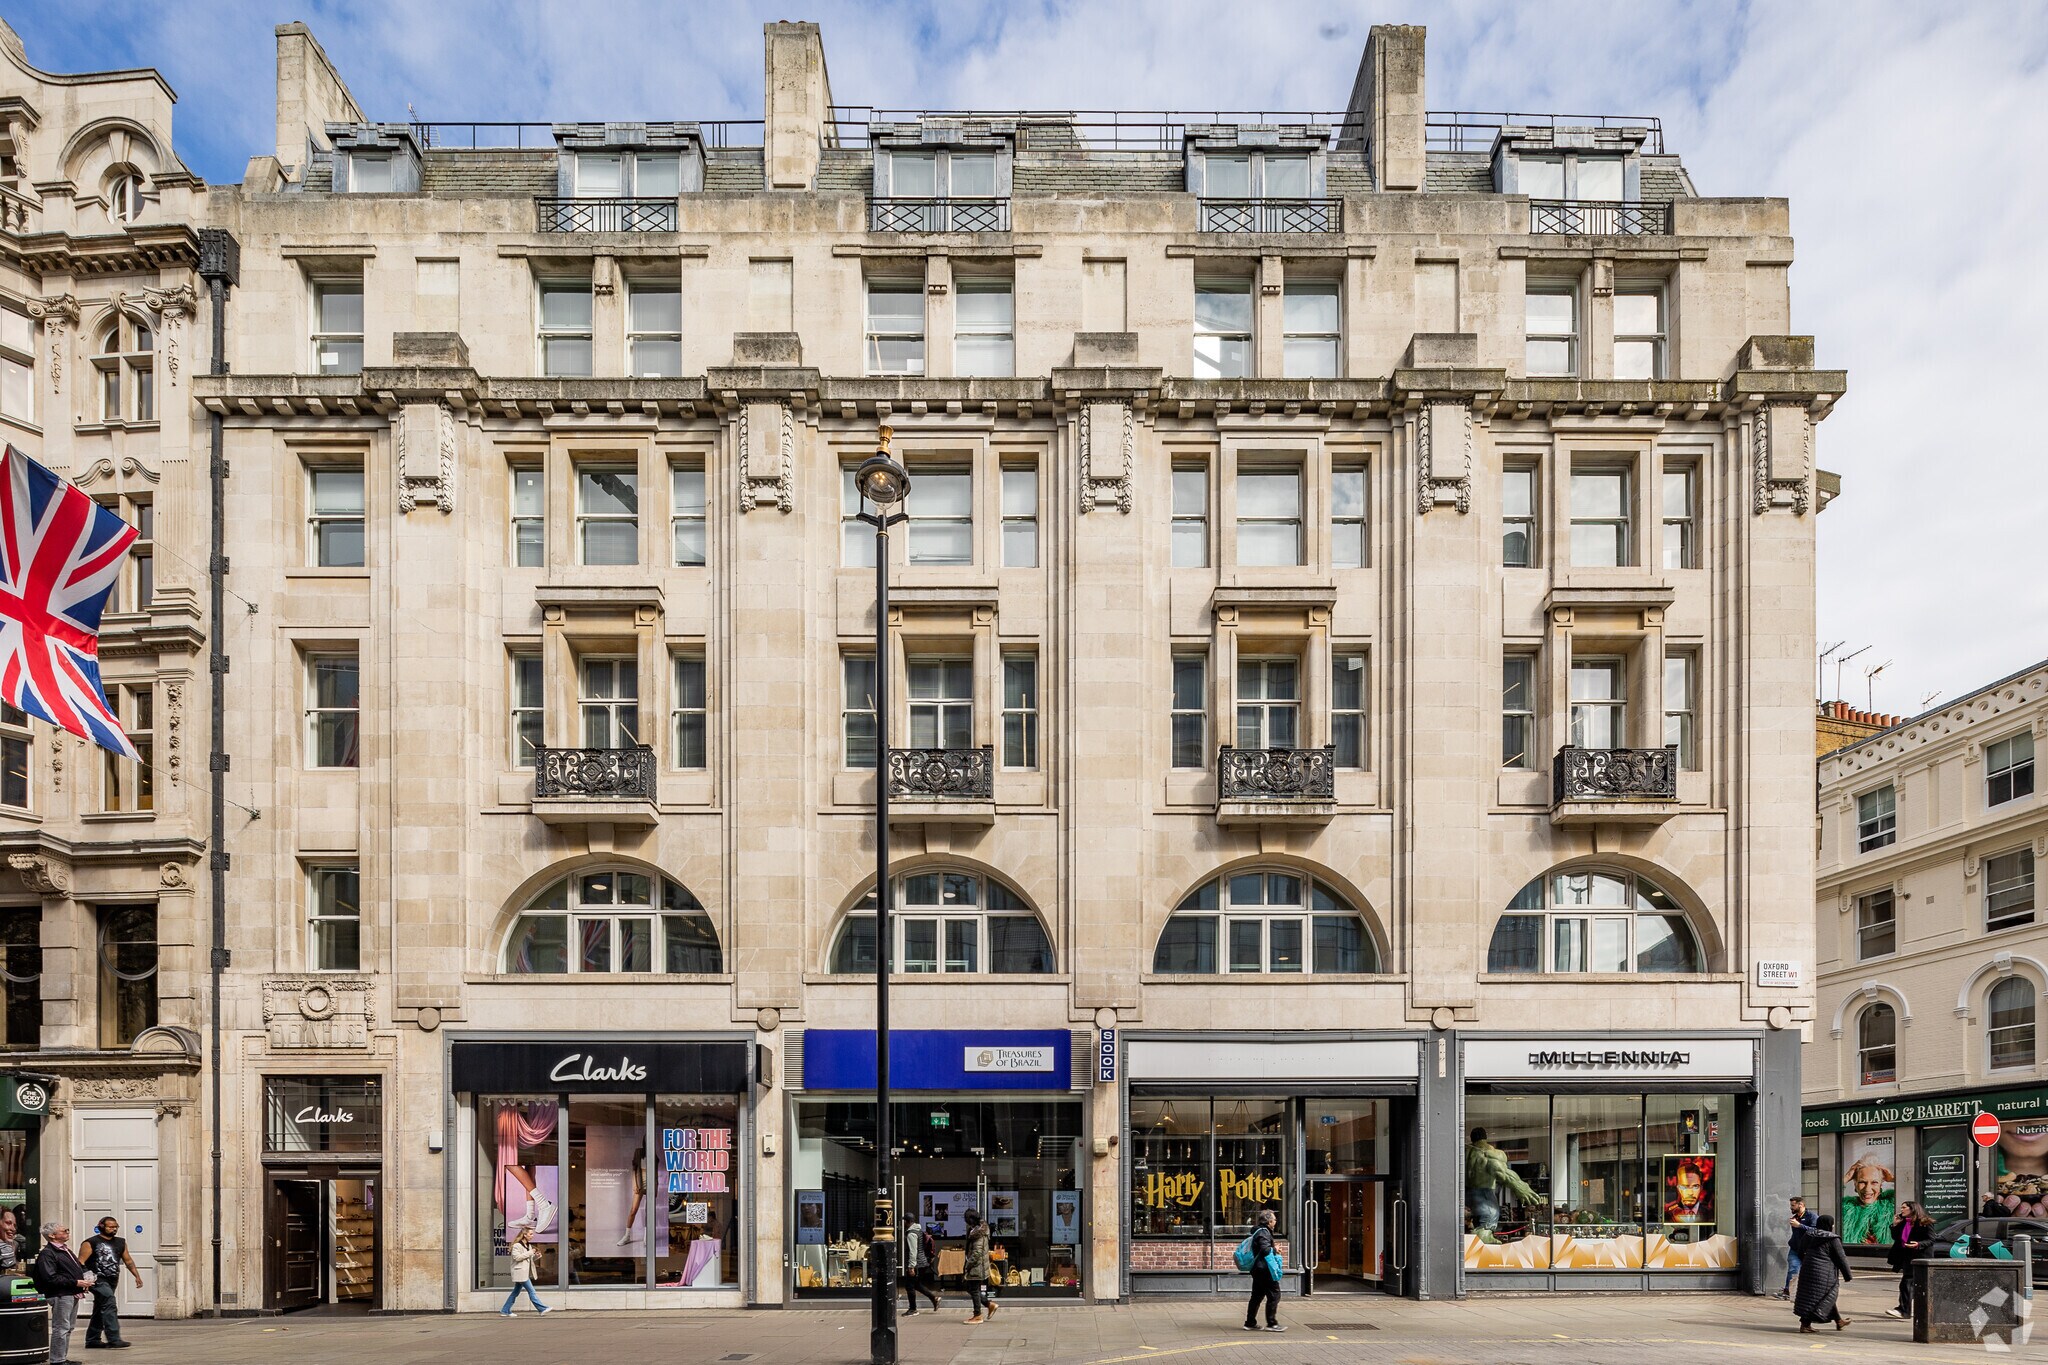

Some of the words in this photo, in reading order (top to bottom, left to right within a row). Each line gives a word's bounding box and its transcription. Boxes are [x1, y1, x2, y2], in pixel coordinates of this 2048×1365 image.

[322, 1024, 366, 1045] HOUSE
[996, 1049, 1042, 1059] TREASURES
[996, 1059, 1009, 1067] OF
[1010, 1058, 1042, 1068] BRAZIL
[1102, 1031, 1113, 1079] SOOK
[1539, 1051, 1683, 1064] MILLENNIA
[550, 1053, 647, 1082] Clarks
[294, 1105, 354, 1124] Clarks
[1840, 1109, 1899, 1127] HOLLAND
[1901, 1107, 1914, 1122] &
[1917, 1100, 1983, 1118] BARRETT
[1997, 1097, 2040, 1111] natural
[1805, 1118, 1829, 1128] foods
[663, 1128, 697, 1150] FOR
[698, 1128, 732, 1150] THE
[1867, 1136, 1892, 1145] Health
[664, 1150, 730, 1171] WORLD
[668, 1172, 730, 1193] AHEAD.
[877, 1187, 888, 1195] 26
[1142, 1172, 1205, 1209] Harry
[1219, 1168, 1284, 1219] Potter
